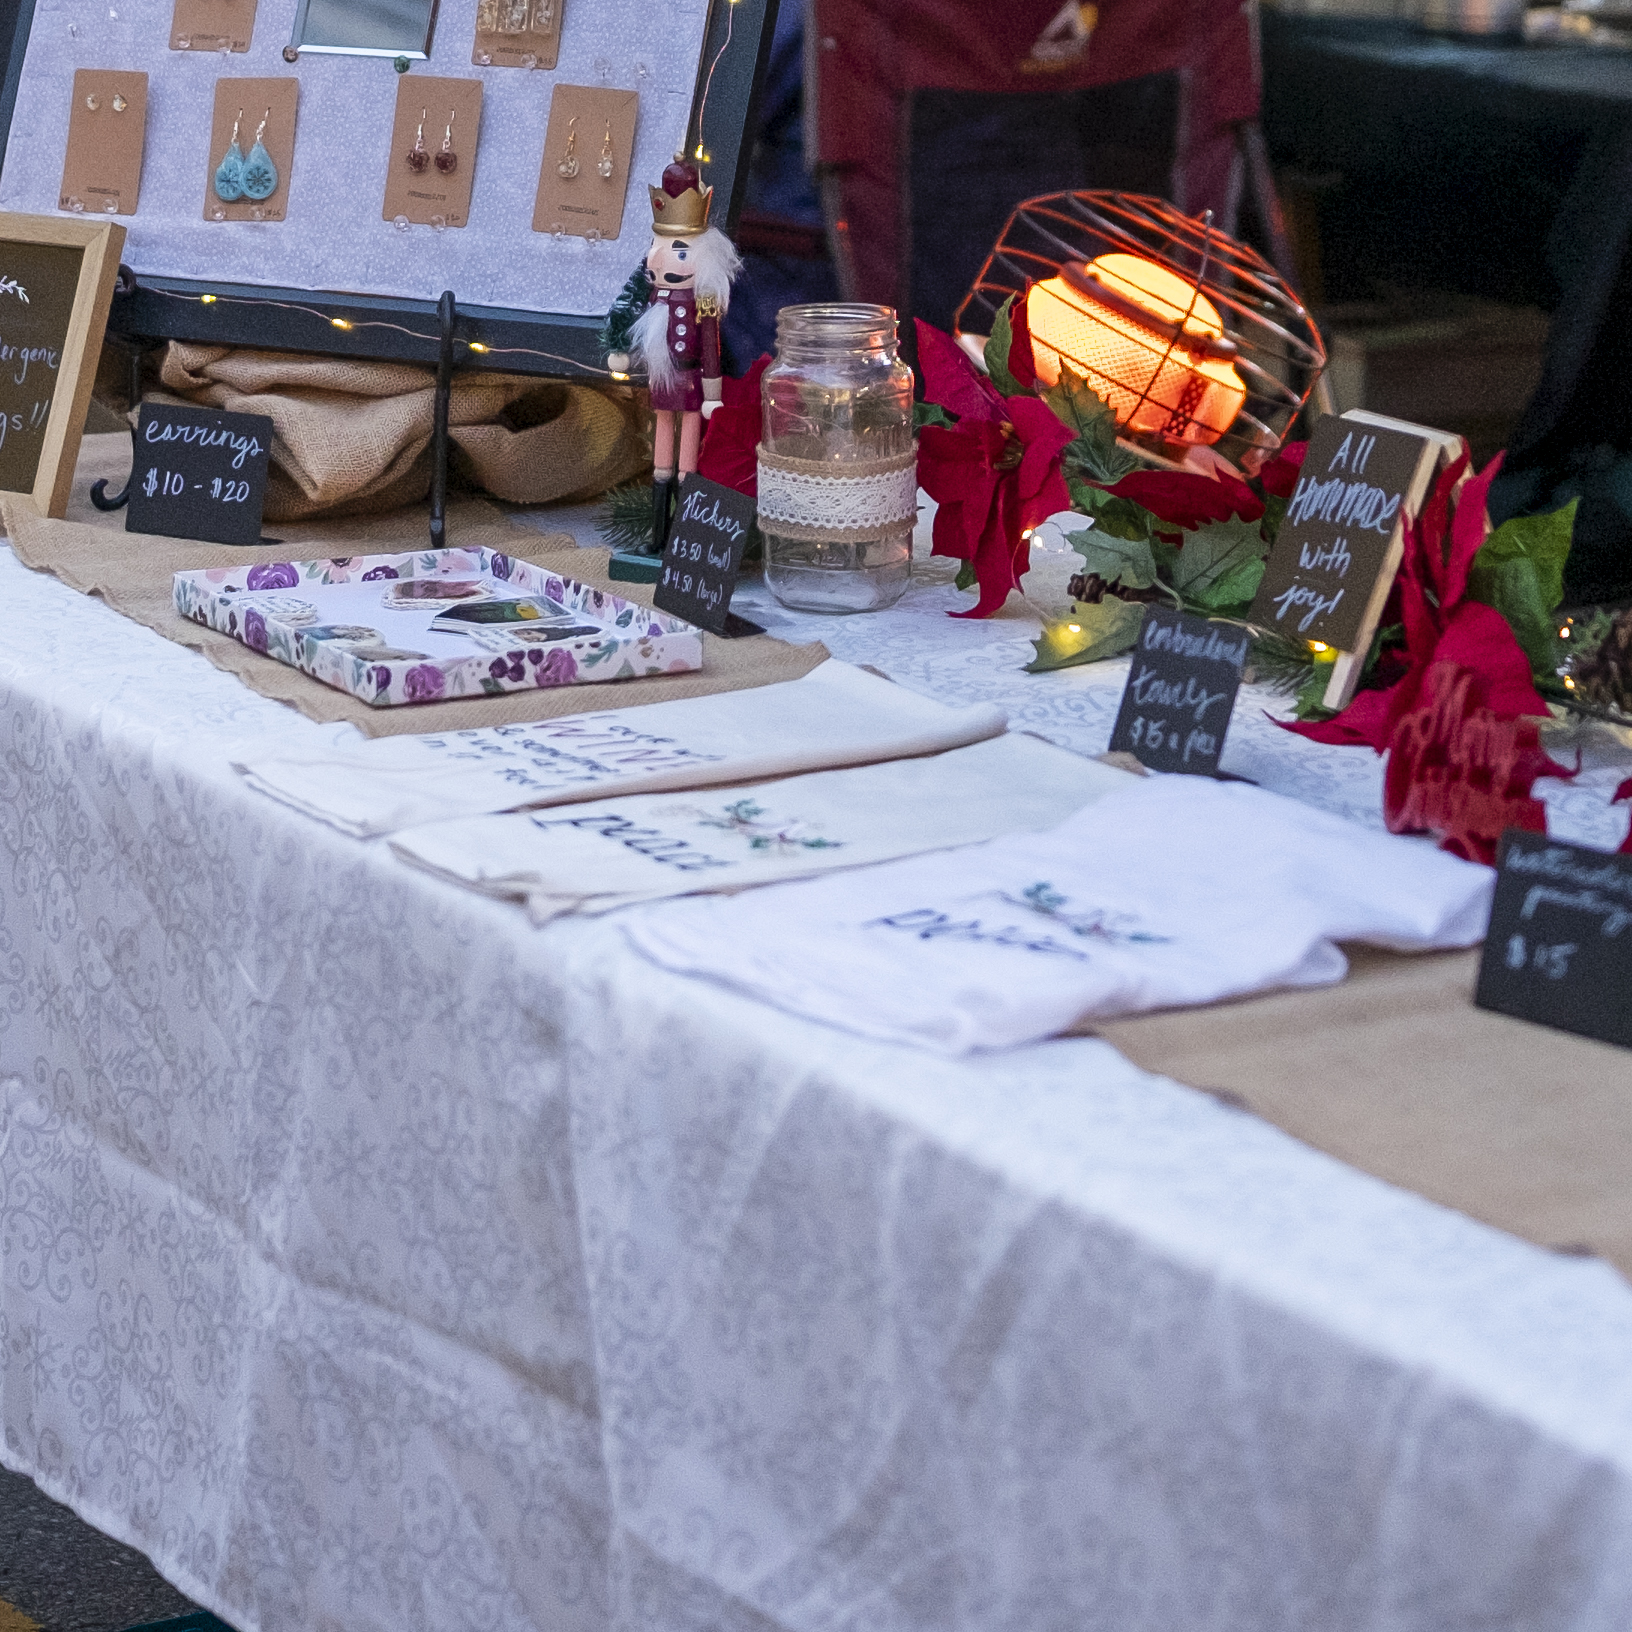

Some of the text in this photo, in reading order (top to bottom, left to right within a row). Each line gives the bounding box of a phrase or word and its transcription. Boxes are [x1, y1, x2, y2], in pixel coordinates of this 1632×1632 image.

[145, 420, 264, 469] earrings
[1328, 431, 1376, 474] All
[142, 467, 184, 498] $10
[210, 477, 250, 503] $20
[662, 566, 693, 593] $4.50
[1273, 575, 1346, 633] joy!
